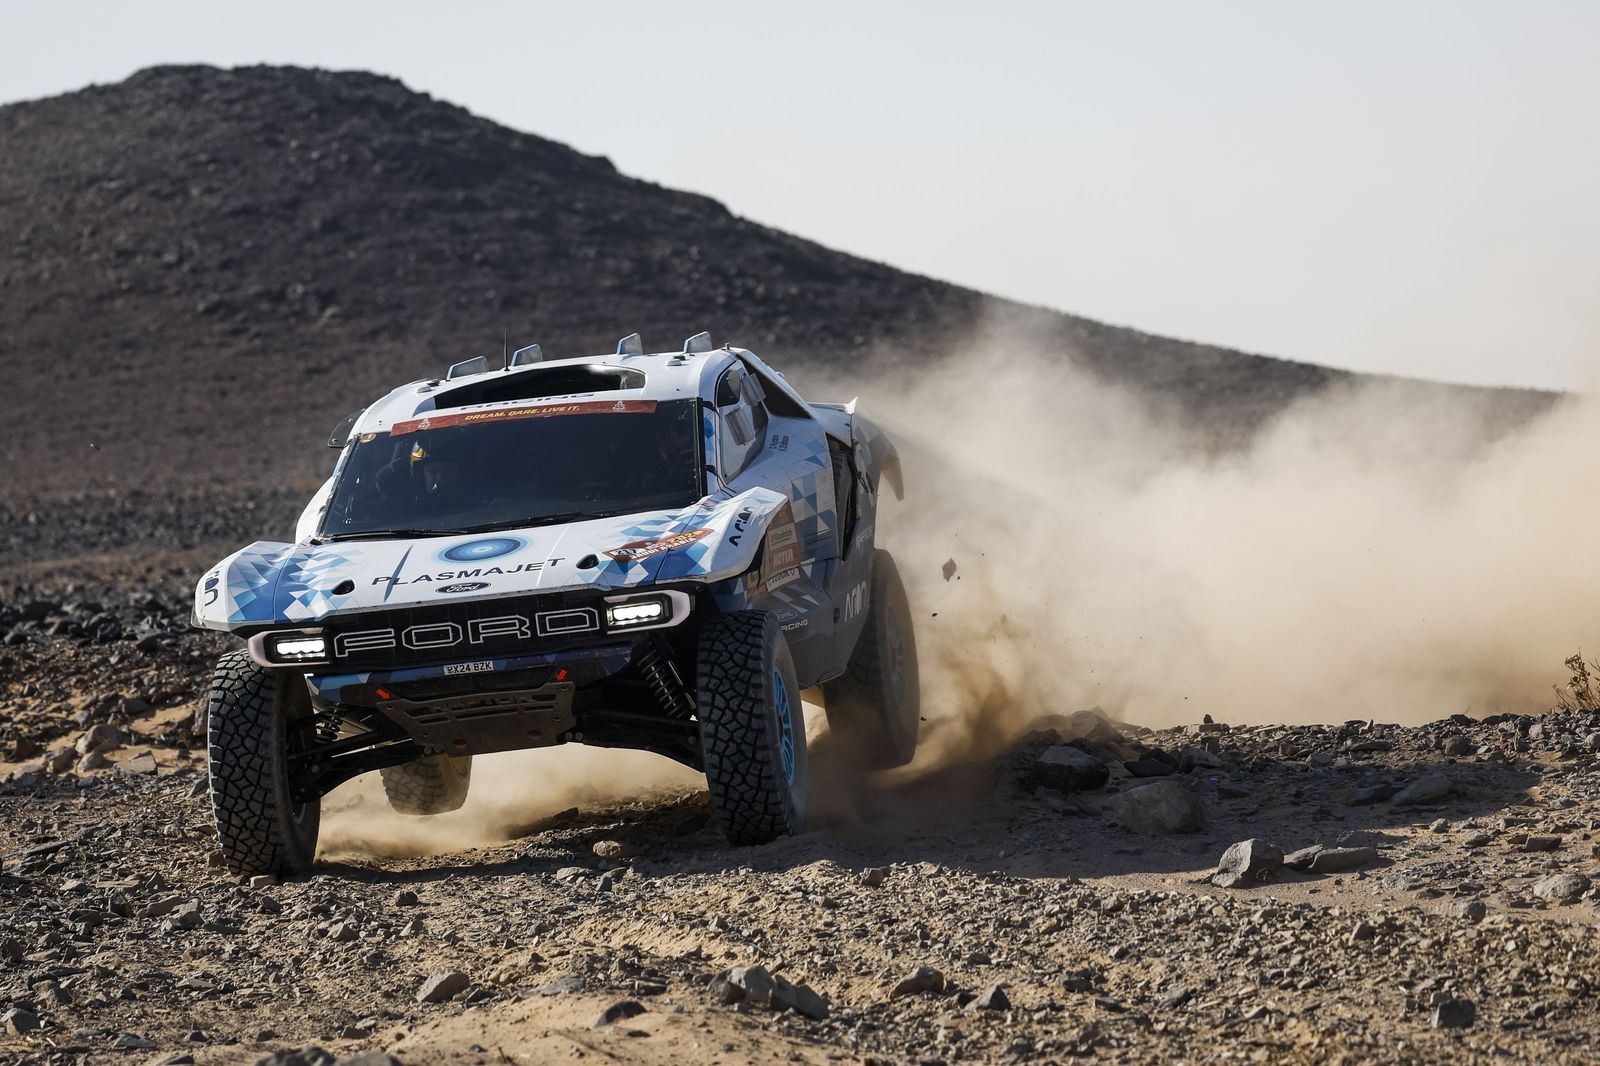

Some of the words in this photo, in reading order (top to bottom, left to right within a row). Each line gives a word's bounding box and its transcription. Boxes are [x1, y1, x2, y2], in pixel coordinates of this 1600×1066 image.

[465, 412, 505, 421] DREAM.
[509, 408, 540, 417] DARE.
[630, 549, 660, 560] SAUDI
[660, 537, 697, 551] ARABIA
[371, 558, 566, 586] PLASMAJET
[446, 583, 481, 593] Ford
[781, 619, 808, 631] ACING
[334, 607, 600, 658] FORD
[447, 663, 471, 674] PX24
[473, 661, 493, 672] BZK
